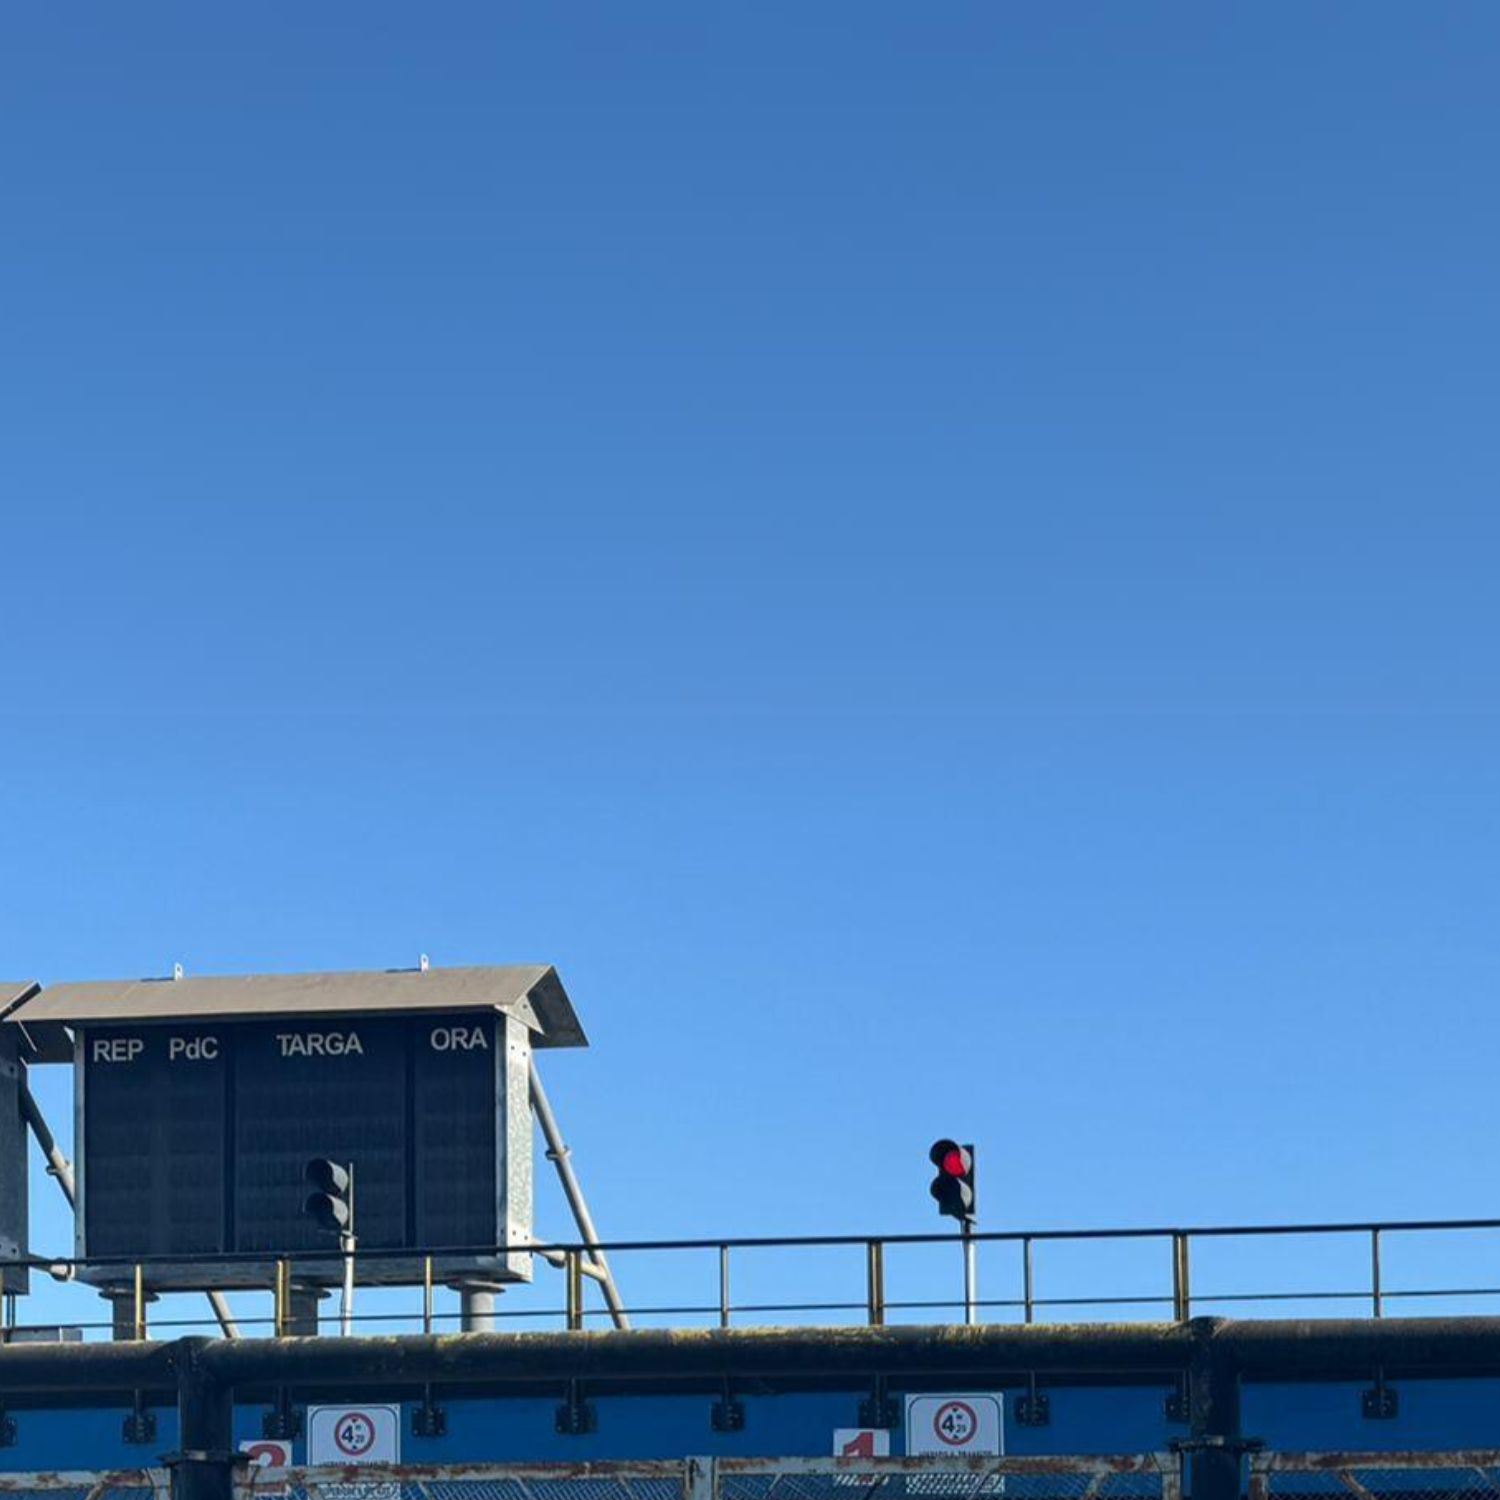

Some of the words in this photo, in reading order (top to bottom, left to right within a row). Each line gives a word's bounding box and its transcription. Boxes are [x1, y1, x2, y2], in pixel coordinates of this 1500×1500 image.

[93, 1038, 144, 1062] REP
[169, 1036, 218, 1060] PdC
[276, 1032, 363, 1057] TARGA
[430, 1026, 488, 1051] ORA
